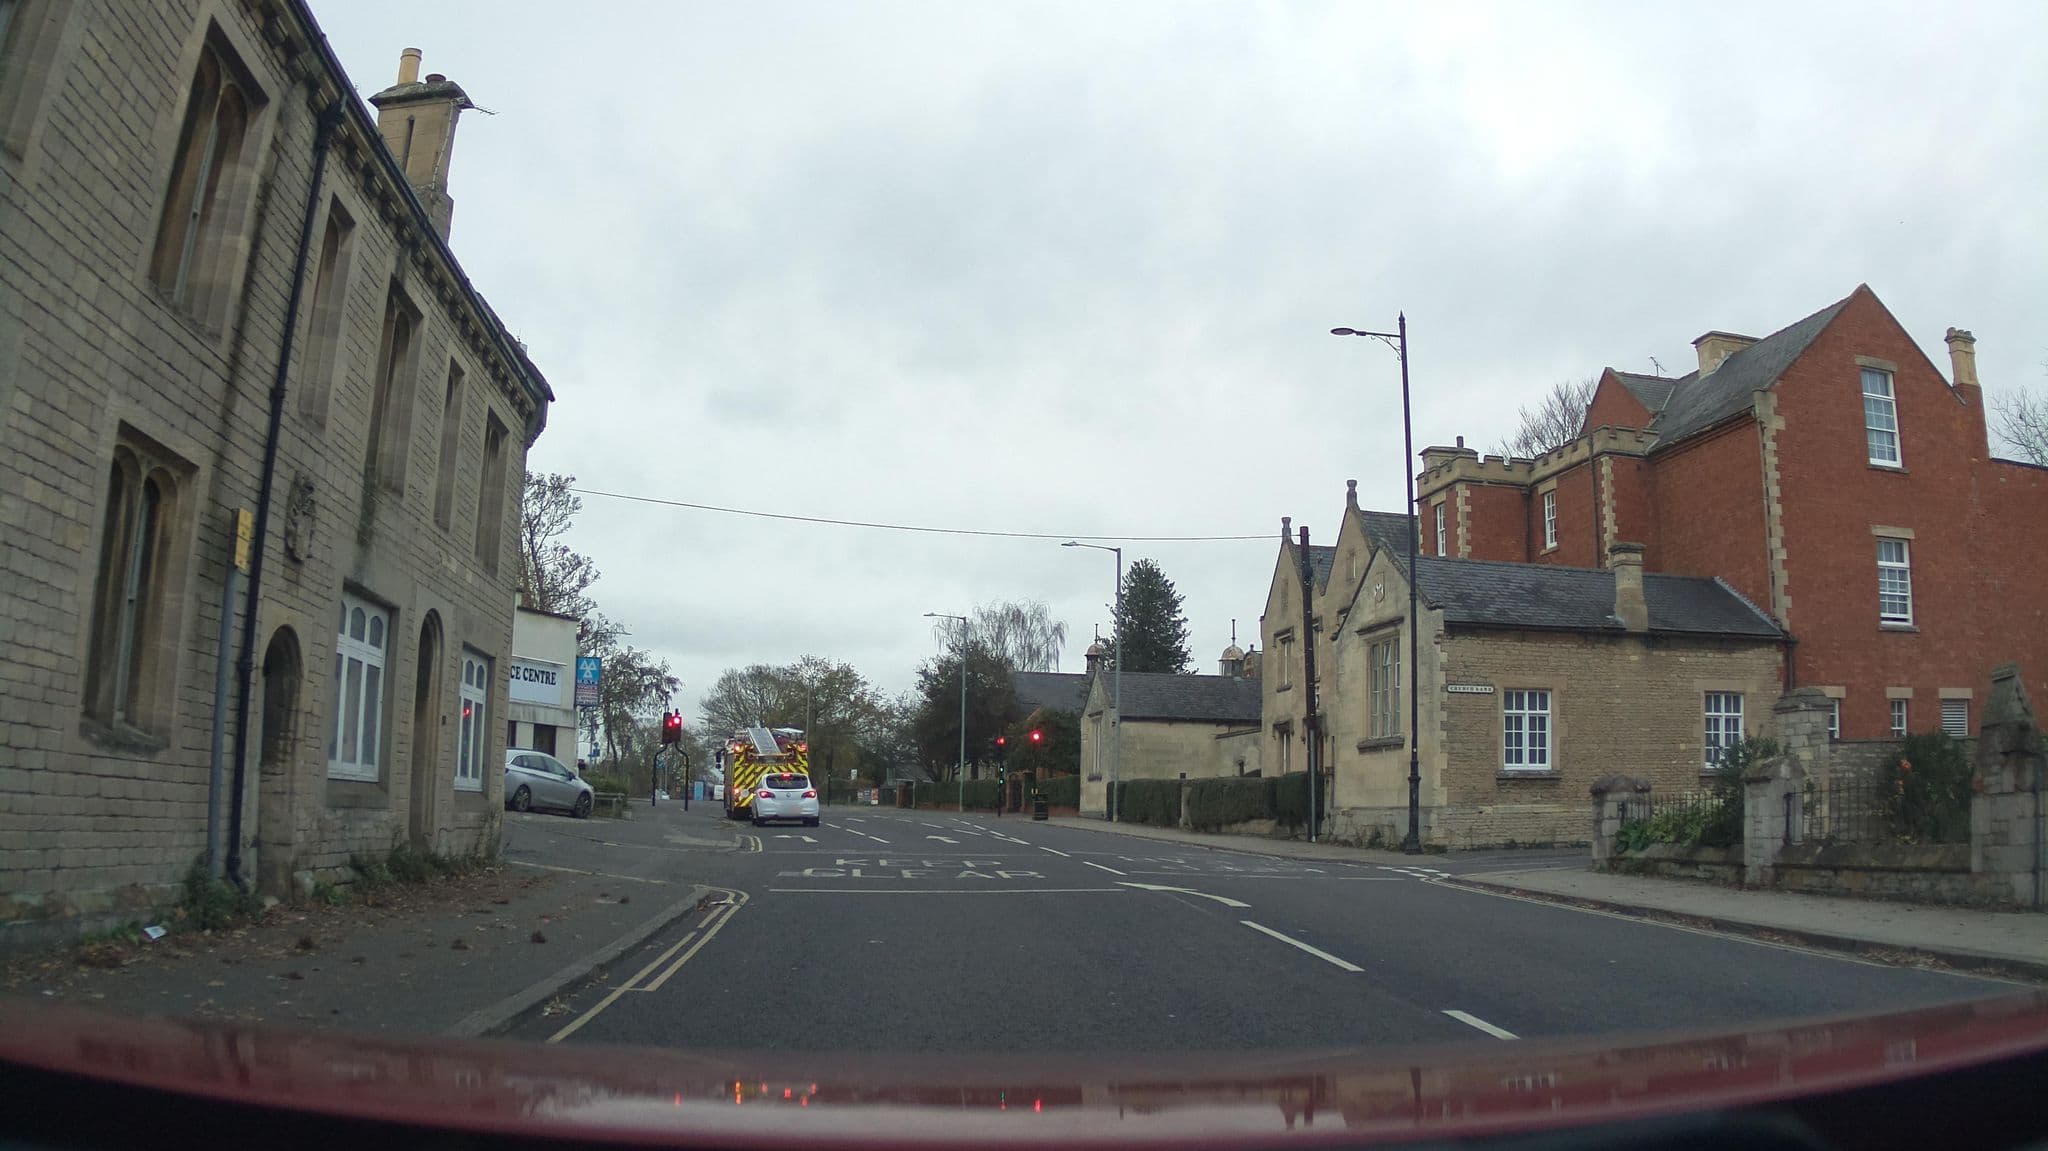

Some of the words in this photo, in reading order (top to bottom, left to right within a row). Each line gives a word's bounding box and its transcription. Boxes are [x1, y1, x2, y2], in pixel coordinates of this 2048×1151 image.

[523, 667, 557, 686] CENTRE
[835, 859, 1002, 868] KEEP
[803, 868, 1047, 879] CLEAR
